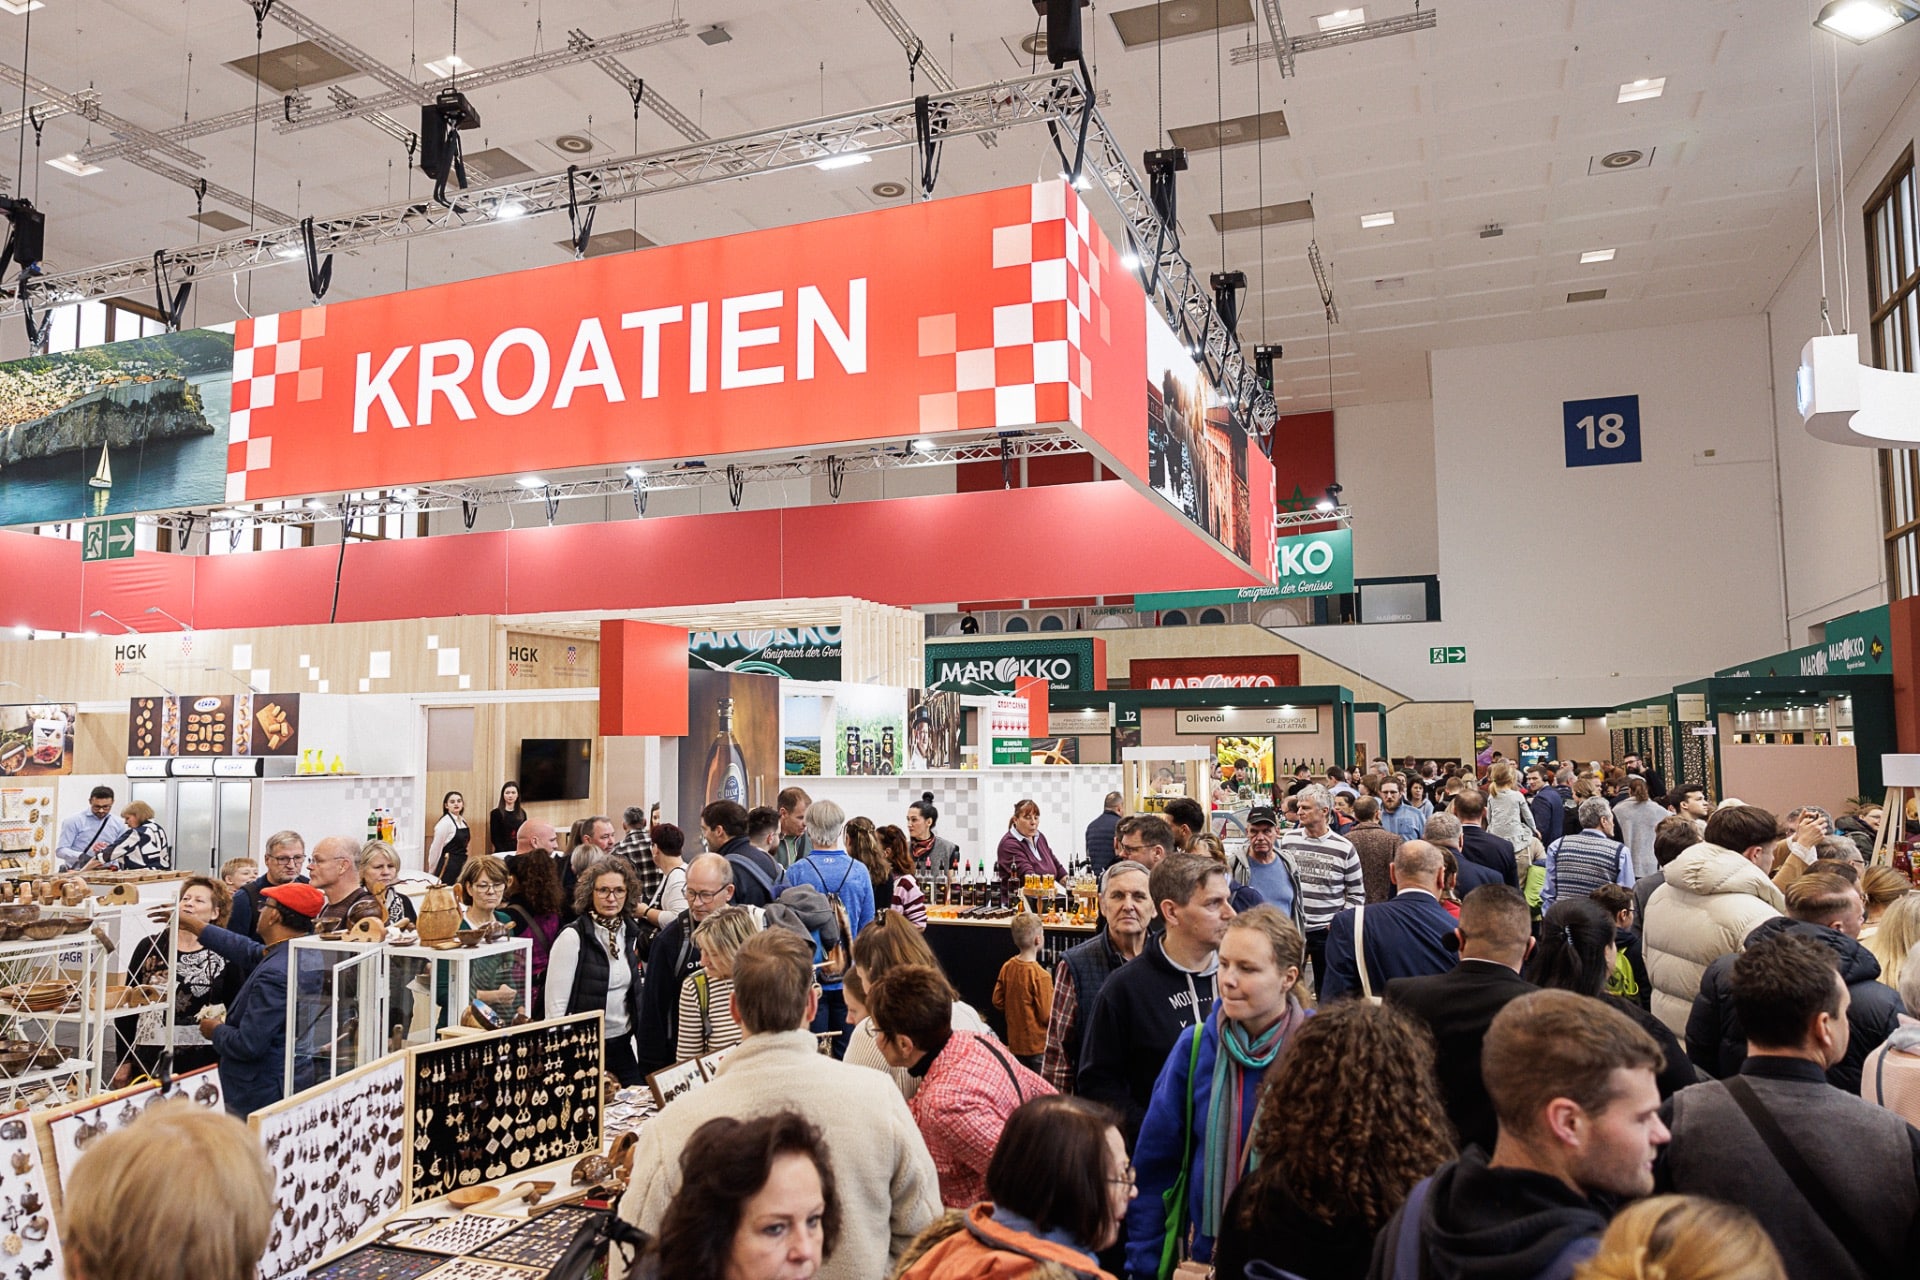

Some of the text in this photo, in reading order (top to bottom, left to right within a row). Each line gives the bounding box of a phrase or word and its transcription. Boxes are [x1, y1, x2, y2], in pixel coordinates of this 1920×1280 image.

[353, 278, 867, 433] KROATIEN
[1576, 413, 1626, 450] 18
[1281, 583, 1296, 594] der
[1298, 580, 1333, 592] Genüsse
[115, 643, 147, 660] HGK
[509, 646, 538, 662] HGK
[761, 647, 804, 664] Königreich
[805, 646, 821, 657] der
[1829, 637, 1865, 661] MAROKKO
[941, 656, 1071, 683] MAROKKO
[1186, 714, 1224, 723] Olivenöl
